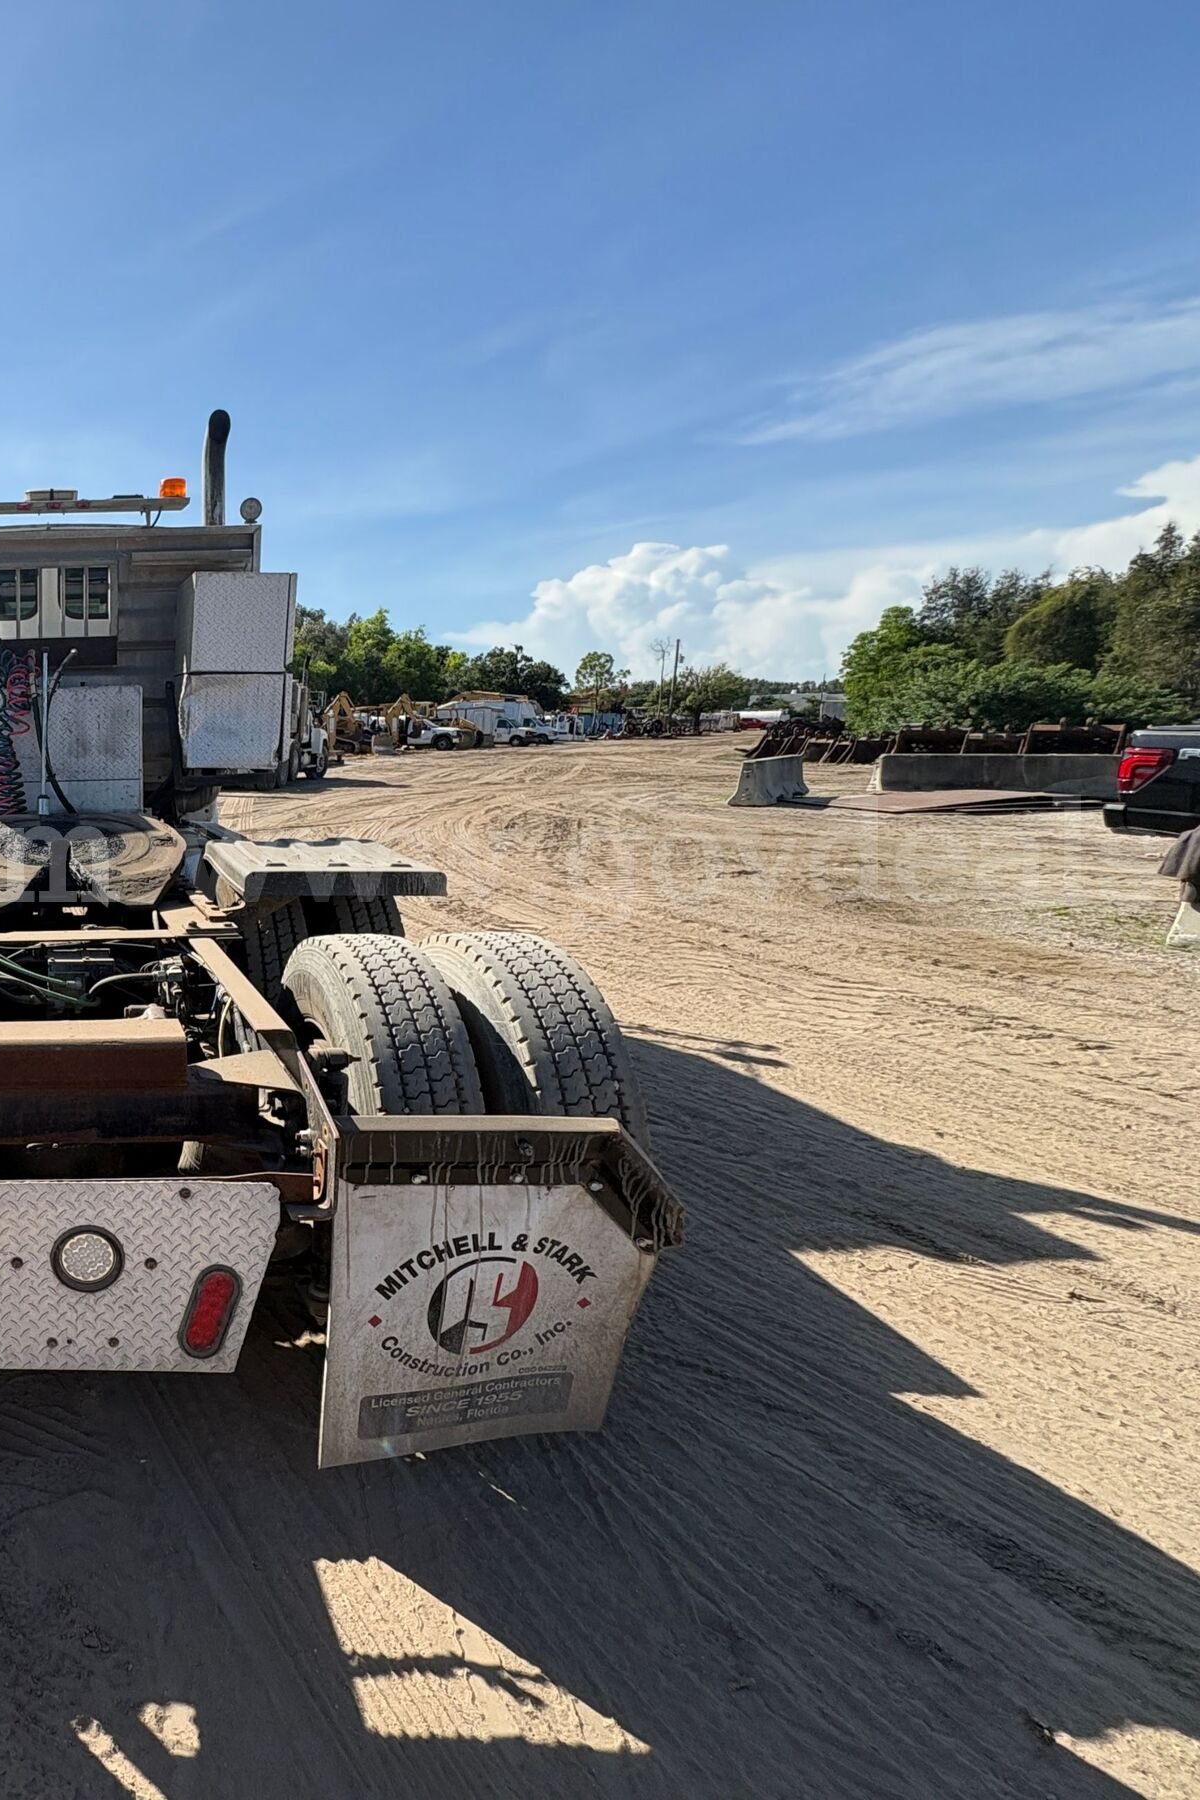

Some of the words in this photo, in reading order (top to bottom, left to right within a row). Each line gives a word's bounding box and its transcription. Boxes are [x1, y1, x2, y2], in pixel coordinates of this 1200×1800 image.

[374, 1232, 502, 1301] MITCHELL
[512, 1233, 529, 1252] &
[532, 1236, 598, 1285] STARK
[381, 1336, 490, 1377] Construction
[496, 1346, 534, 1366] Co.,
[534, 1320, 573, 1346] Inc.
[371, 1392, 430, 1409] Licensed
[433, 1381, 482, 1401] General
[485, 1376, 561, 1393] Contractors
[405, 1397, 471, 1418] SINCE
[476, 1390, 523, 1406] 1955
